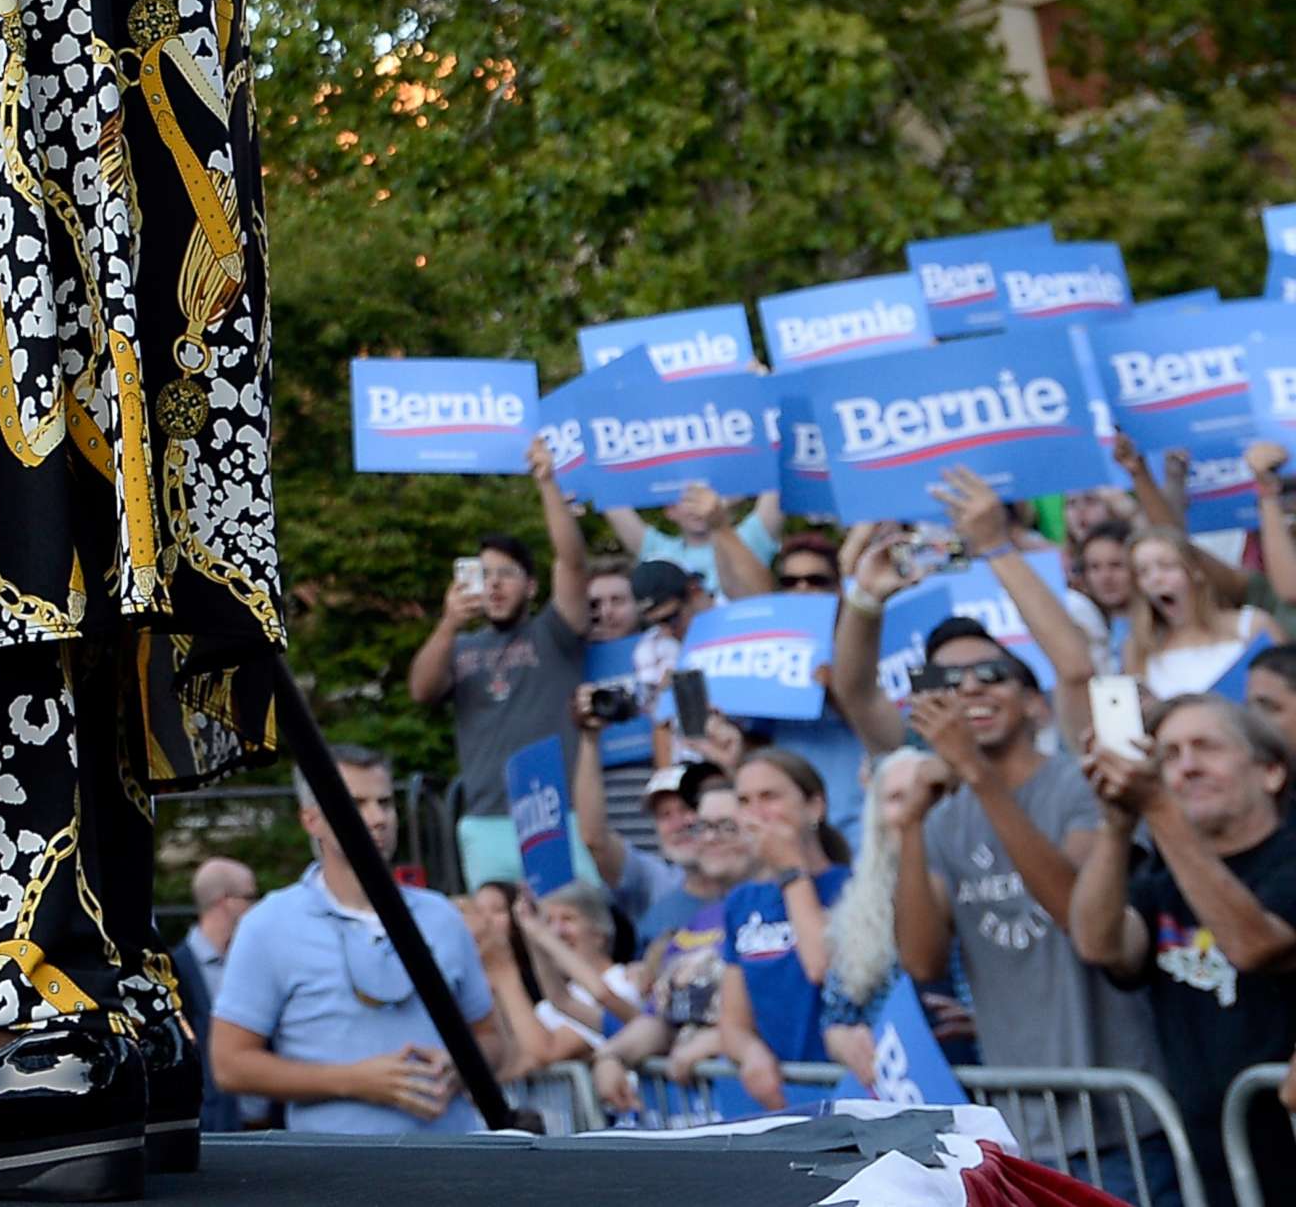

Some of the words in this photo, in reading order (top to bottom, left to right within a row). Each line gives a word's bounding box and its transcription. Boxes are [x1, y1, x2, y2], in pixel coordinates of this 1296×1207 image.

[1004, 264, 1124, 309] Bernie
[775, 300, 916, 353] Bernie
[366, 384, 524, 427] Bernie
[589, 402, 754, 461] Bernie
[832, 369, 1070, 453] Bernie
